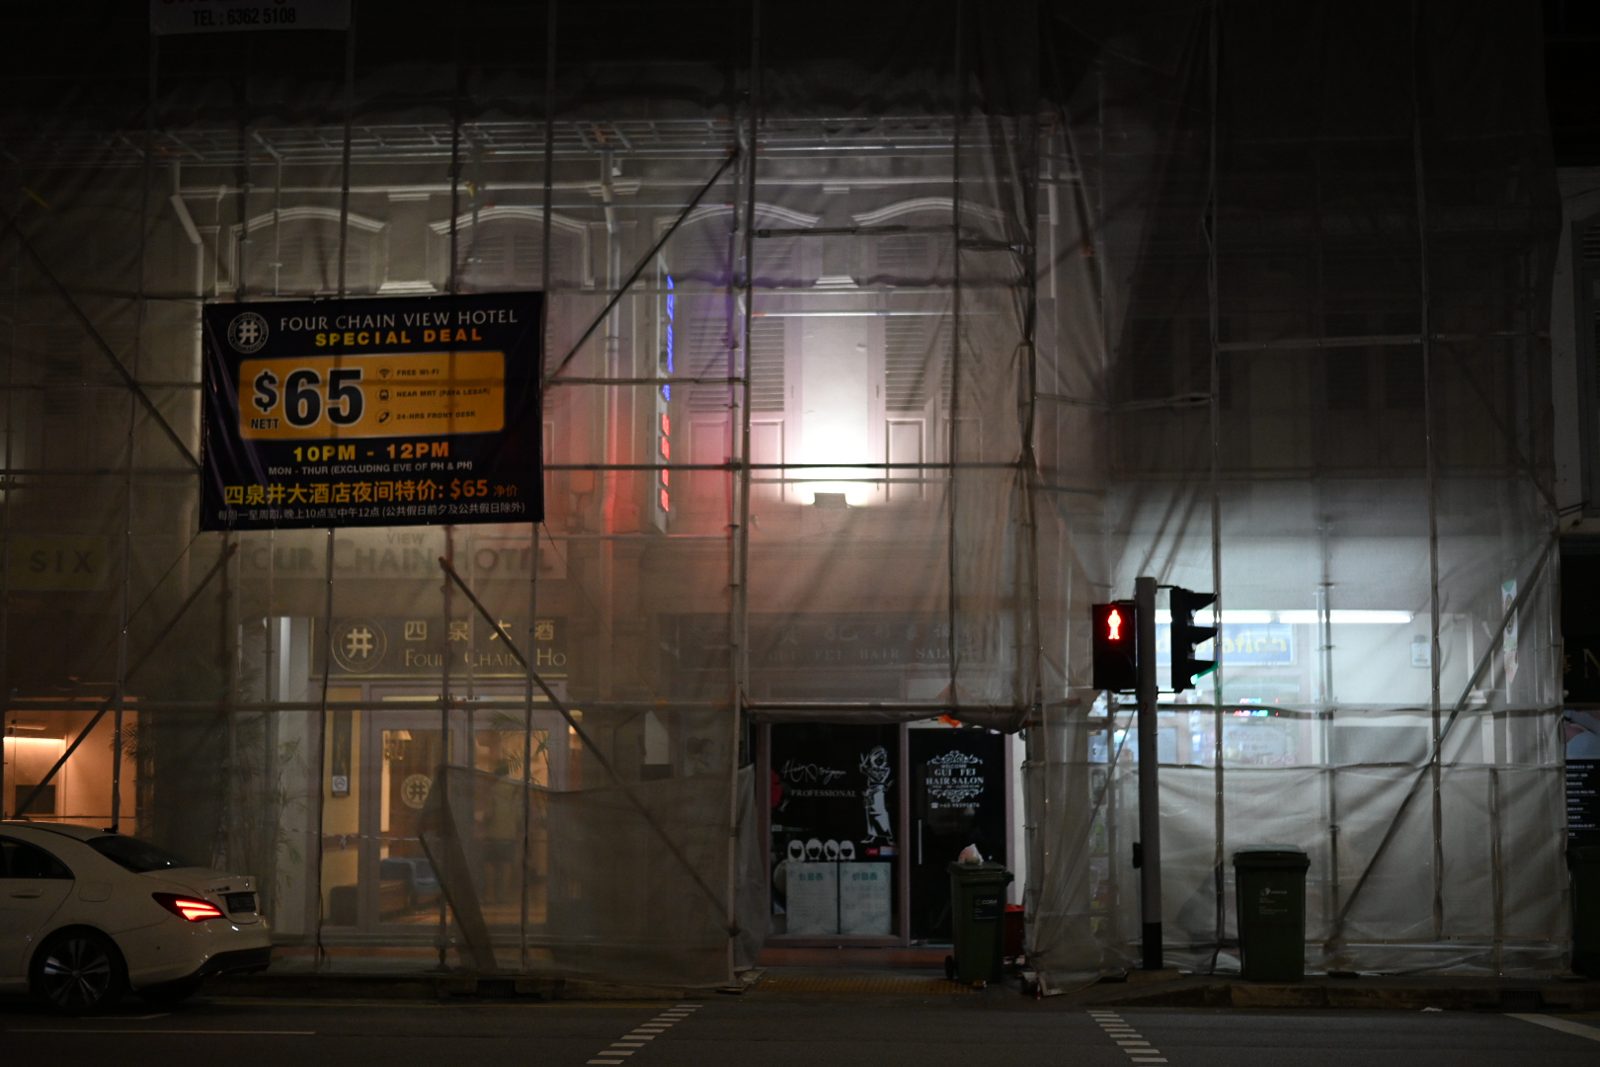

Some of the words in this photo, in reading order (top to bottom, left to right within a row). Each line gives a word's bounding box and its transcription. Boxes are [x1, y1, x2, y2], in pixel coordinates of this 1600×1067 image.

[192, 10, 215, 25] TEL
[227, 9, 258, 24] 6362
[263, 7, 296, 23] 5108
[280, 316, 328, 331] FOUR
[336, 313, 396, 329] CHAIN
[404, 311, 450, 326] VIEW
[458, 308, 518, 324] HOTEL
[315, 330, 411, 347] SPECIAL
[424, 327, 482, 343] DEAL
[252, 367, 365, 428] $65
[251, 418, 279, 430] NETT
[293, 444, 356, 462] 10PM
[386, 442, 449, 460] 12PM
[268, 466, 292, 476] MON
[302, 465, 328, 475] THUR
[331, 463, 390, 475] (EXCLUDING
[393, 462, 412, 472] EVE
[415, 462, 429, 471] OF
[431, 461, 444, 471] PH
[457, 460, 473, 471] PH)
[450, 477, 488, 501] $65
[30, 549, 97, 573] SIX
[926, 777, 950, 785] HAIR
[951, 777, 984, 785] SALON
[934, 768, 952, 776] GUI
[960, 768, 976, 776] FEI
[791, 788, 857, 798] PROFESSIONAL
